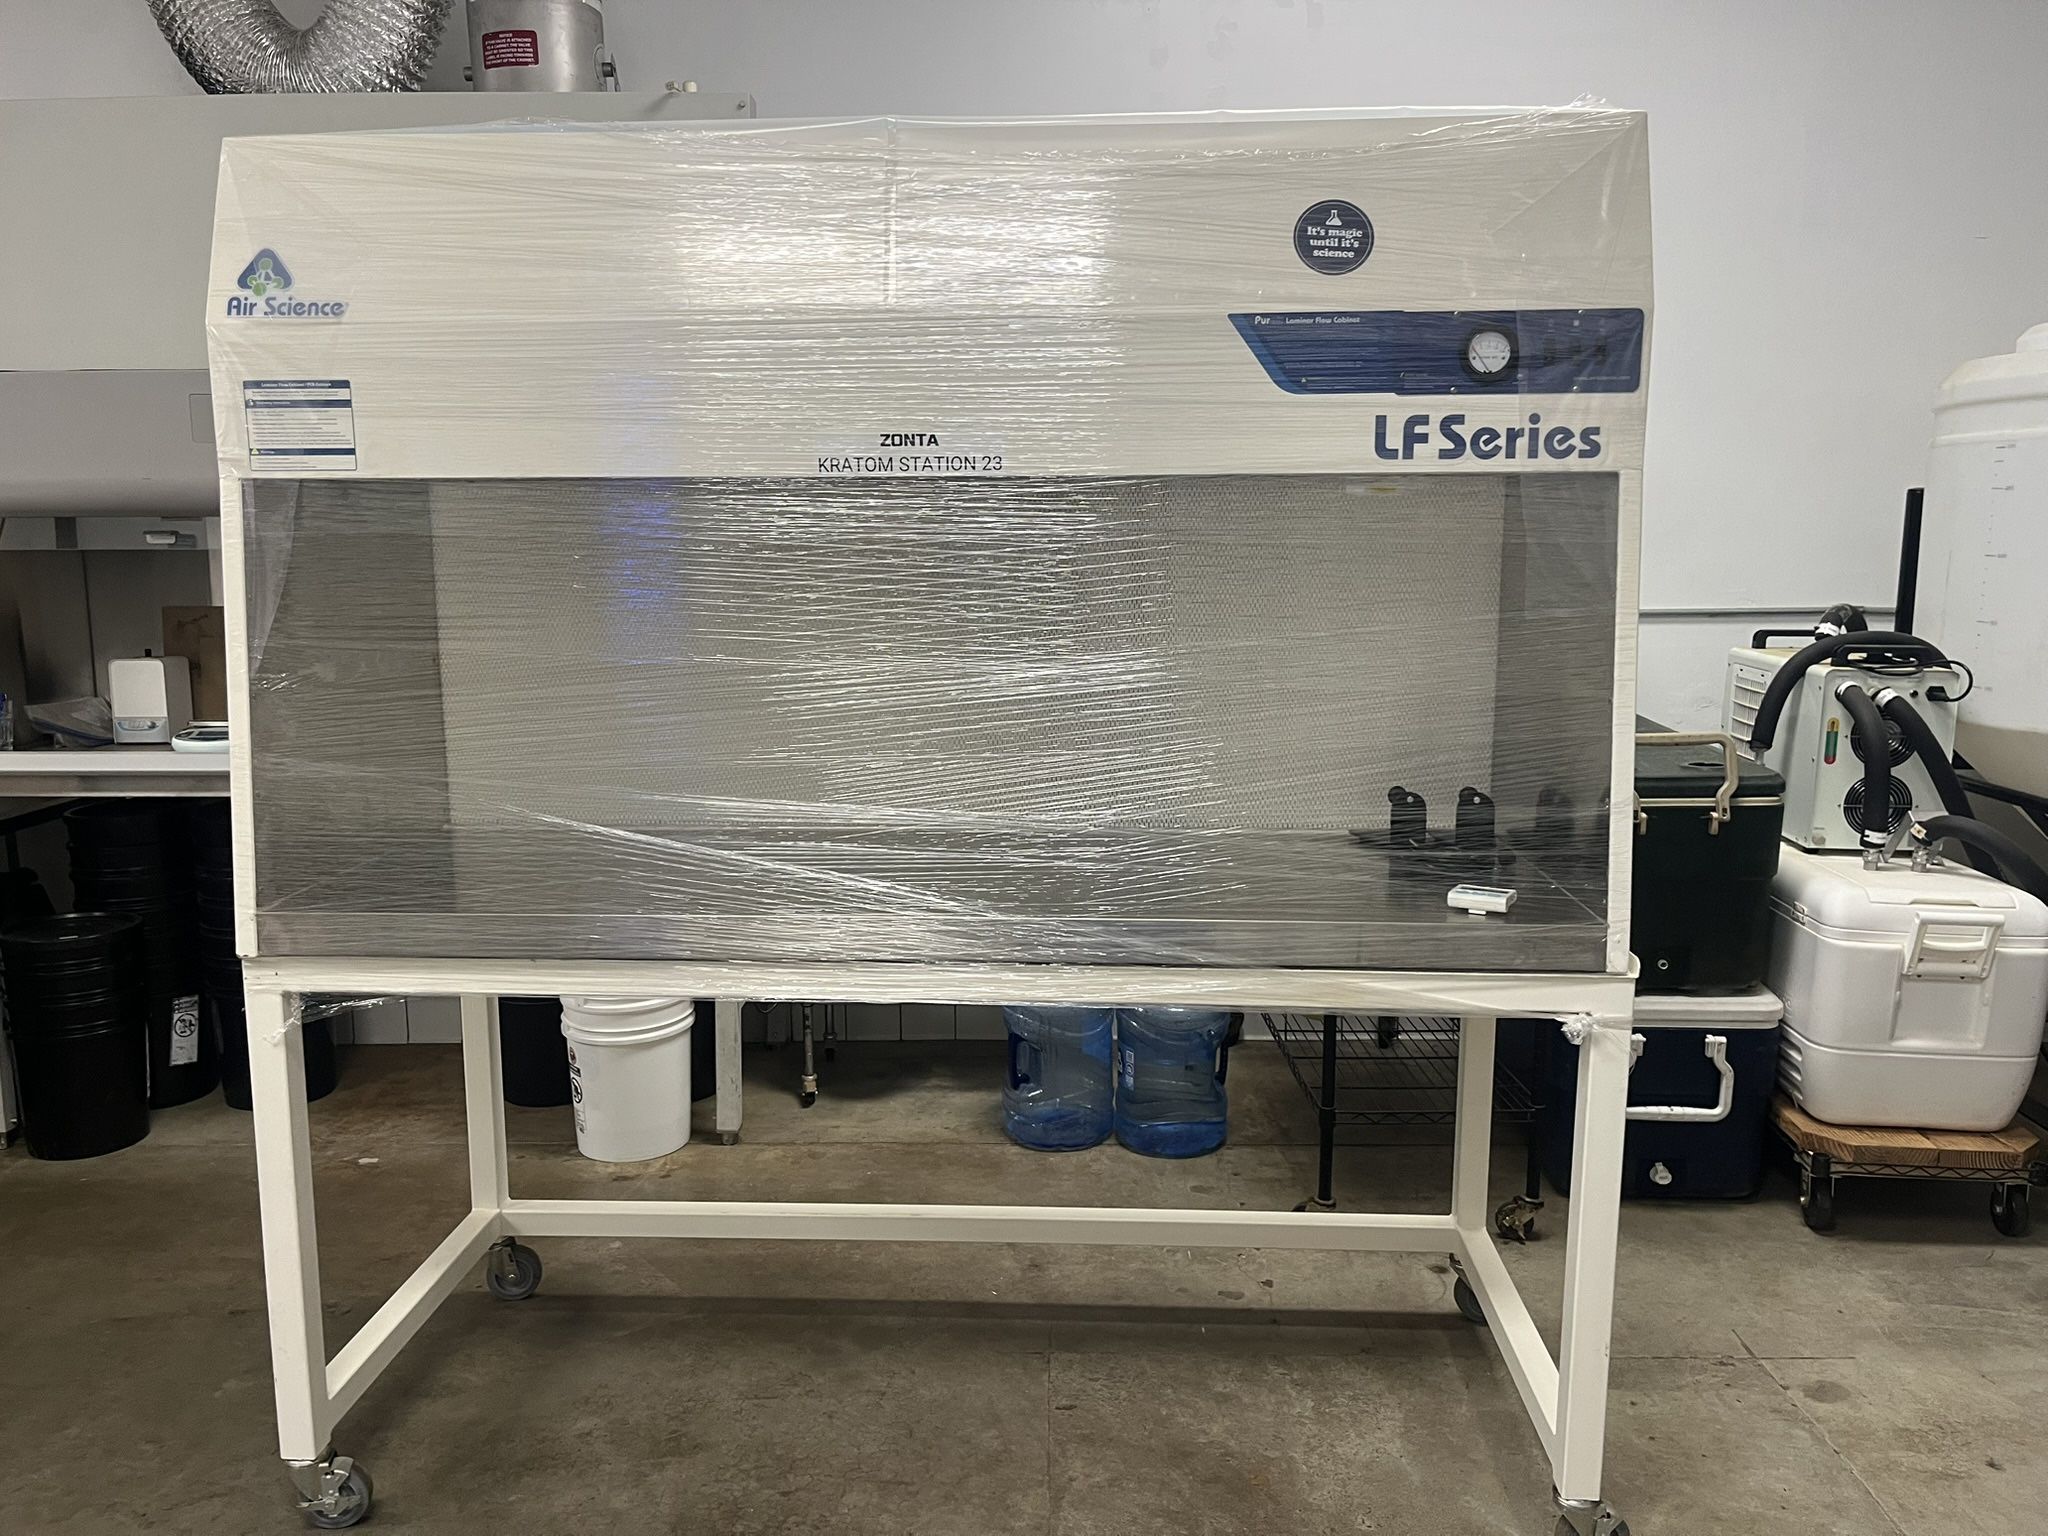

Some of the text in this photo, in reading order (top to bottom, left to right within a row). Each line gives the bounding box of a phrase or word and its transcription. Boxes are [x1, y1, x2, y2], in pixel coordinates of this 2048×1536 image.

[1307, 226, 1363, 239] It's magic
[1310, 237, 1360, 248] until it's
[1312, 248, 1355, 258] science
[227, 296, 345, 317] Air Science
[880, 433, 939, 447] ZONTA
[818, 456, 1003, 473] KRATOM STATION 23
